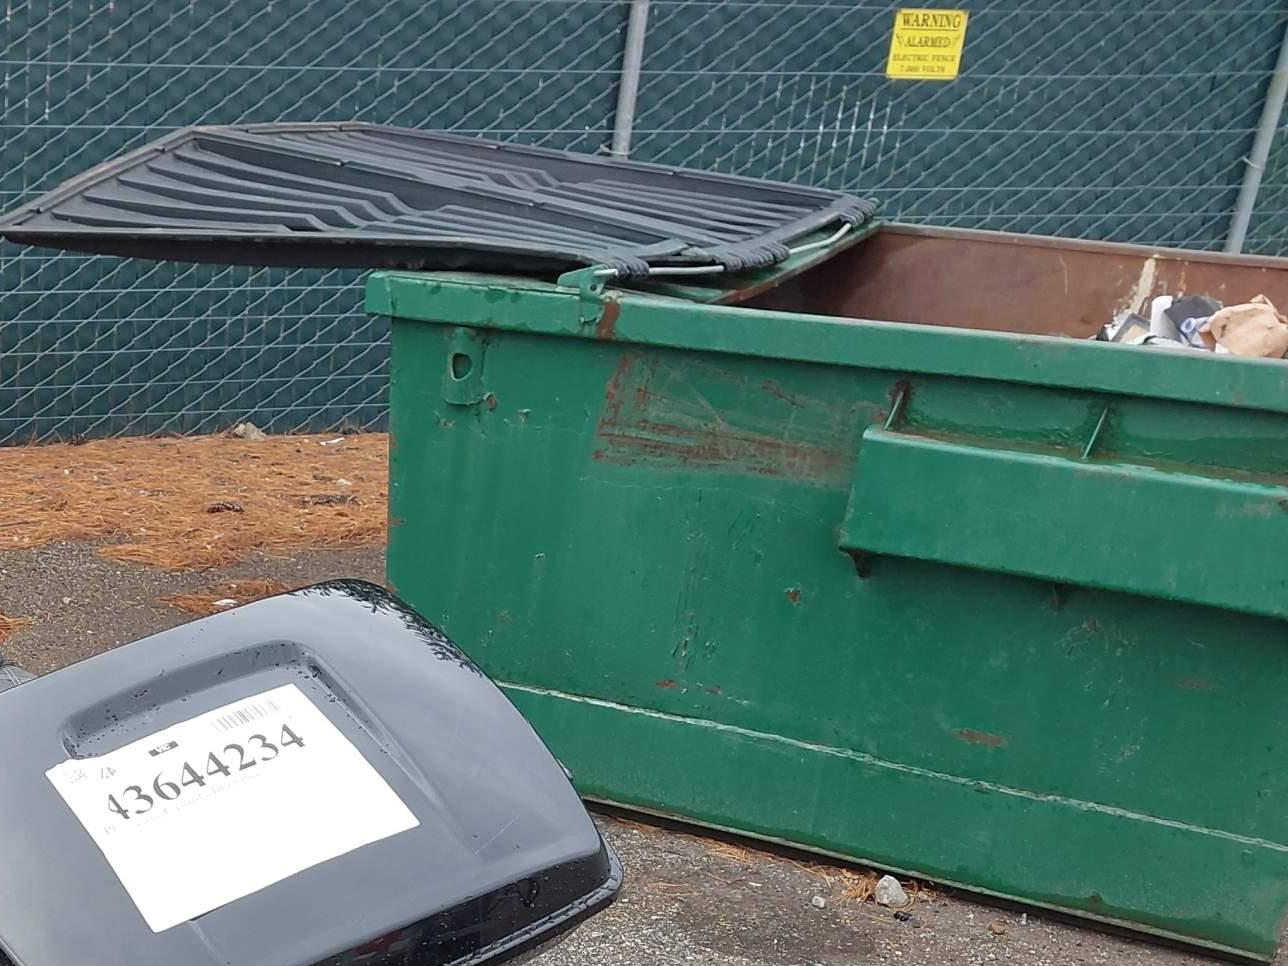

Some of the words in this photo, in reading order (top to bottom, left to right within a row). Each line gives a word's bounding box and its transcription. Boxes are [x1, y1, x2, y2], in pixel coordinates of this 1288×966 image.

[902, 12, 962, 28] WARNING
[904, 35, 951, 48] ALARMED
[107, 723, 306, 820] 43644234
